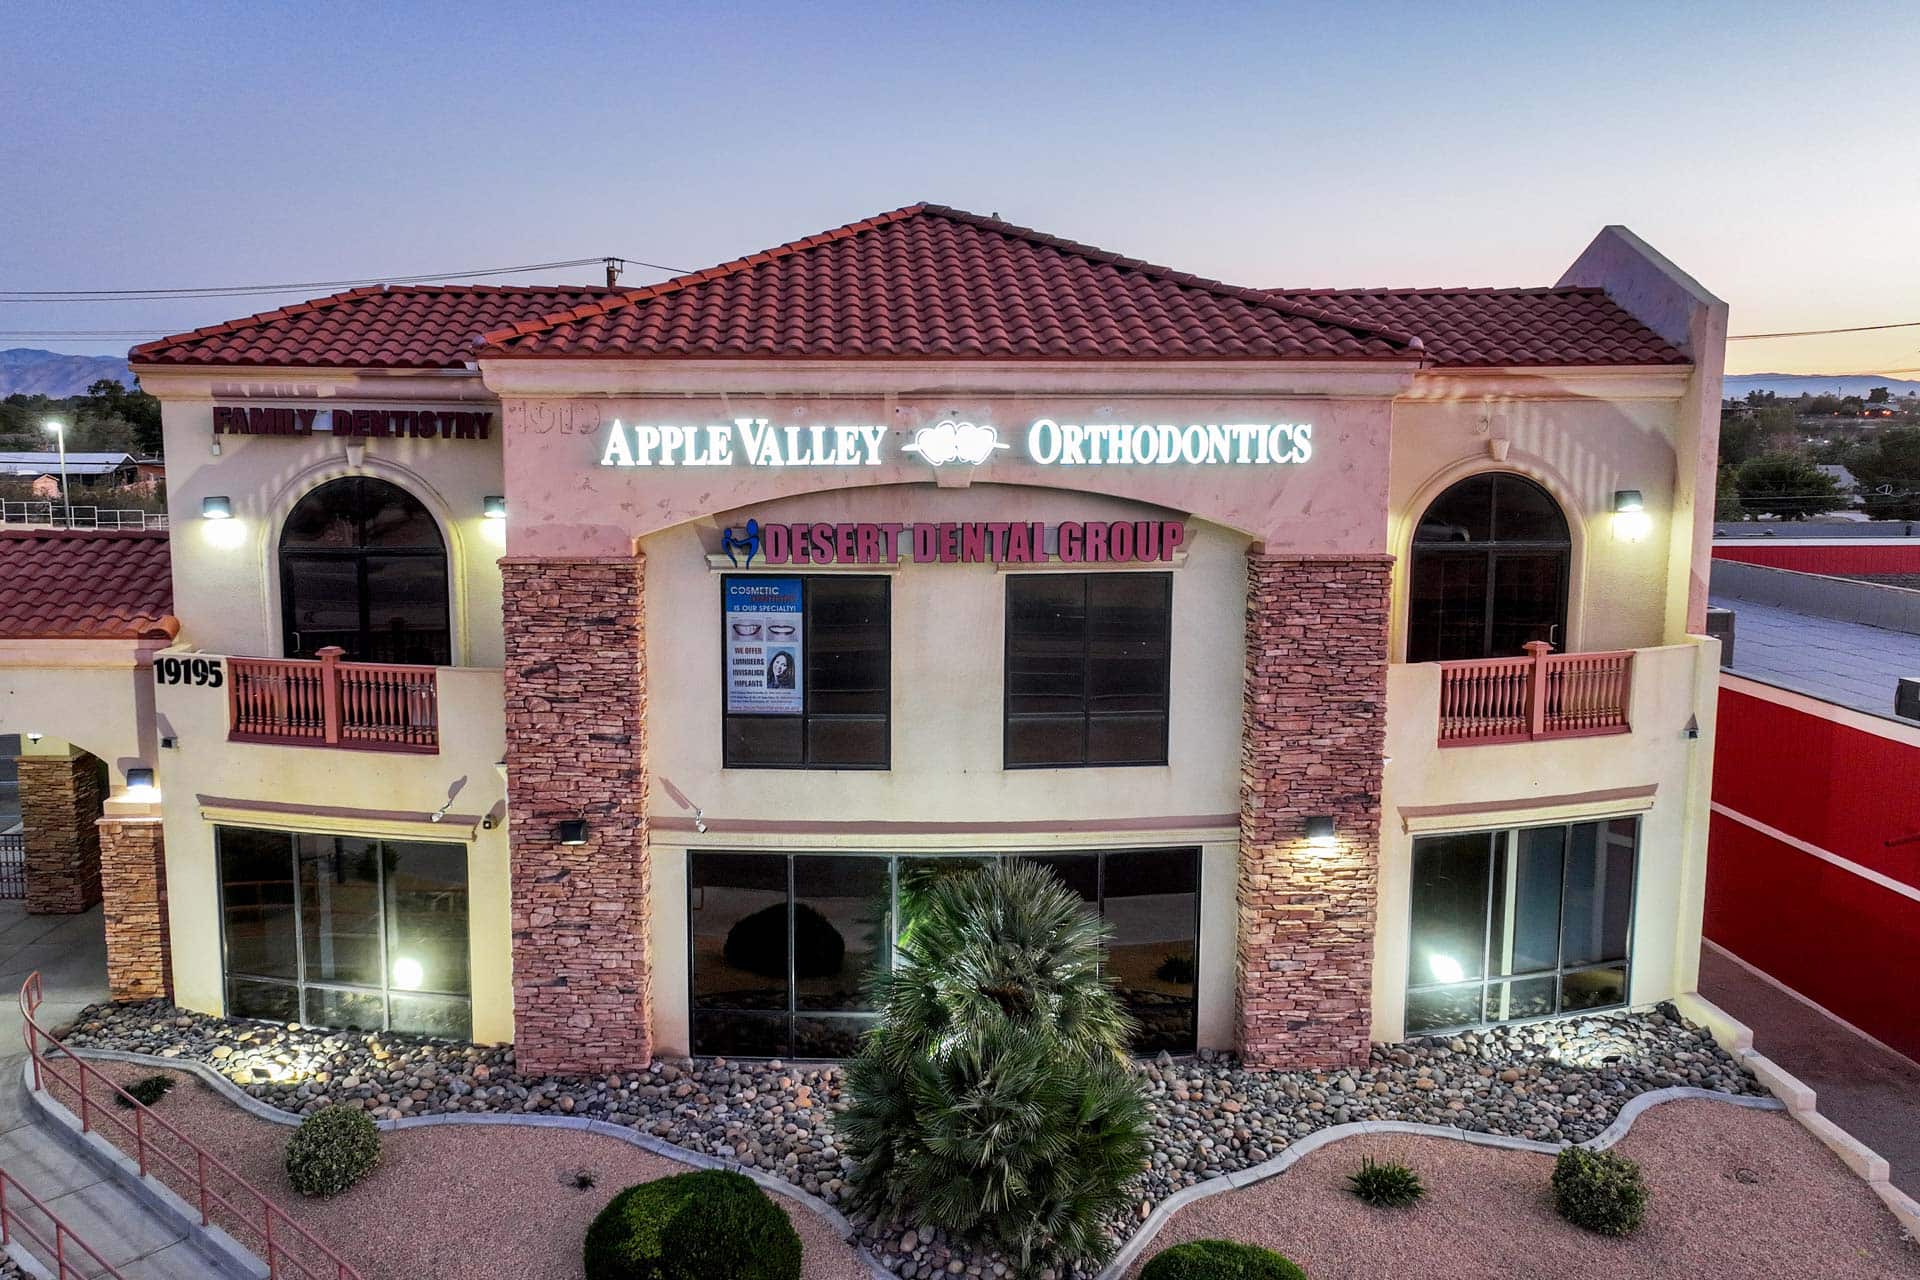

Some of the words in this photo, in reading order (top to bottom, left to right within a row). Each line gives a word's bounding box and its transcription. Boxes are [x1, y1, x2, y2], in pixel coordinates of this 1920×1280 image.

[213, 406, 317, 436] FAMILY
[332, 409, 493, 440] DENTISTRY
[601, 418, 733, 466] APPLE
[734, 418, 888, 466] VALLEY
[1028, 419, 1313, 466] ORTHODONTICS
[764, 523, 904, 564] DESERT
[913, 521, 1050, 563] DENTAL
[1058, 521, 1185, 563] GROUP
[730, 586, 780, 595] COSMETIC
[153, 657, 223, 688] 19195
